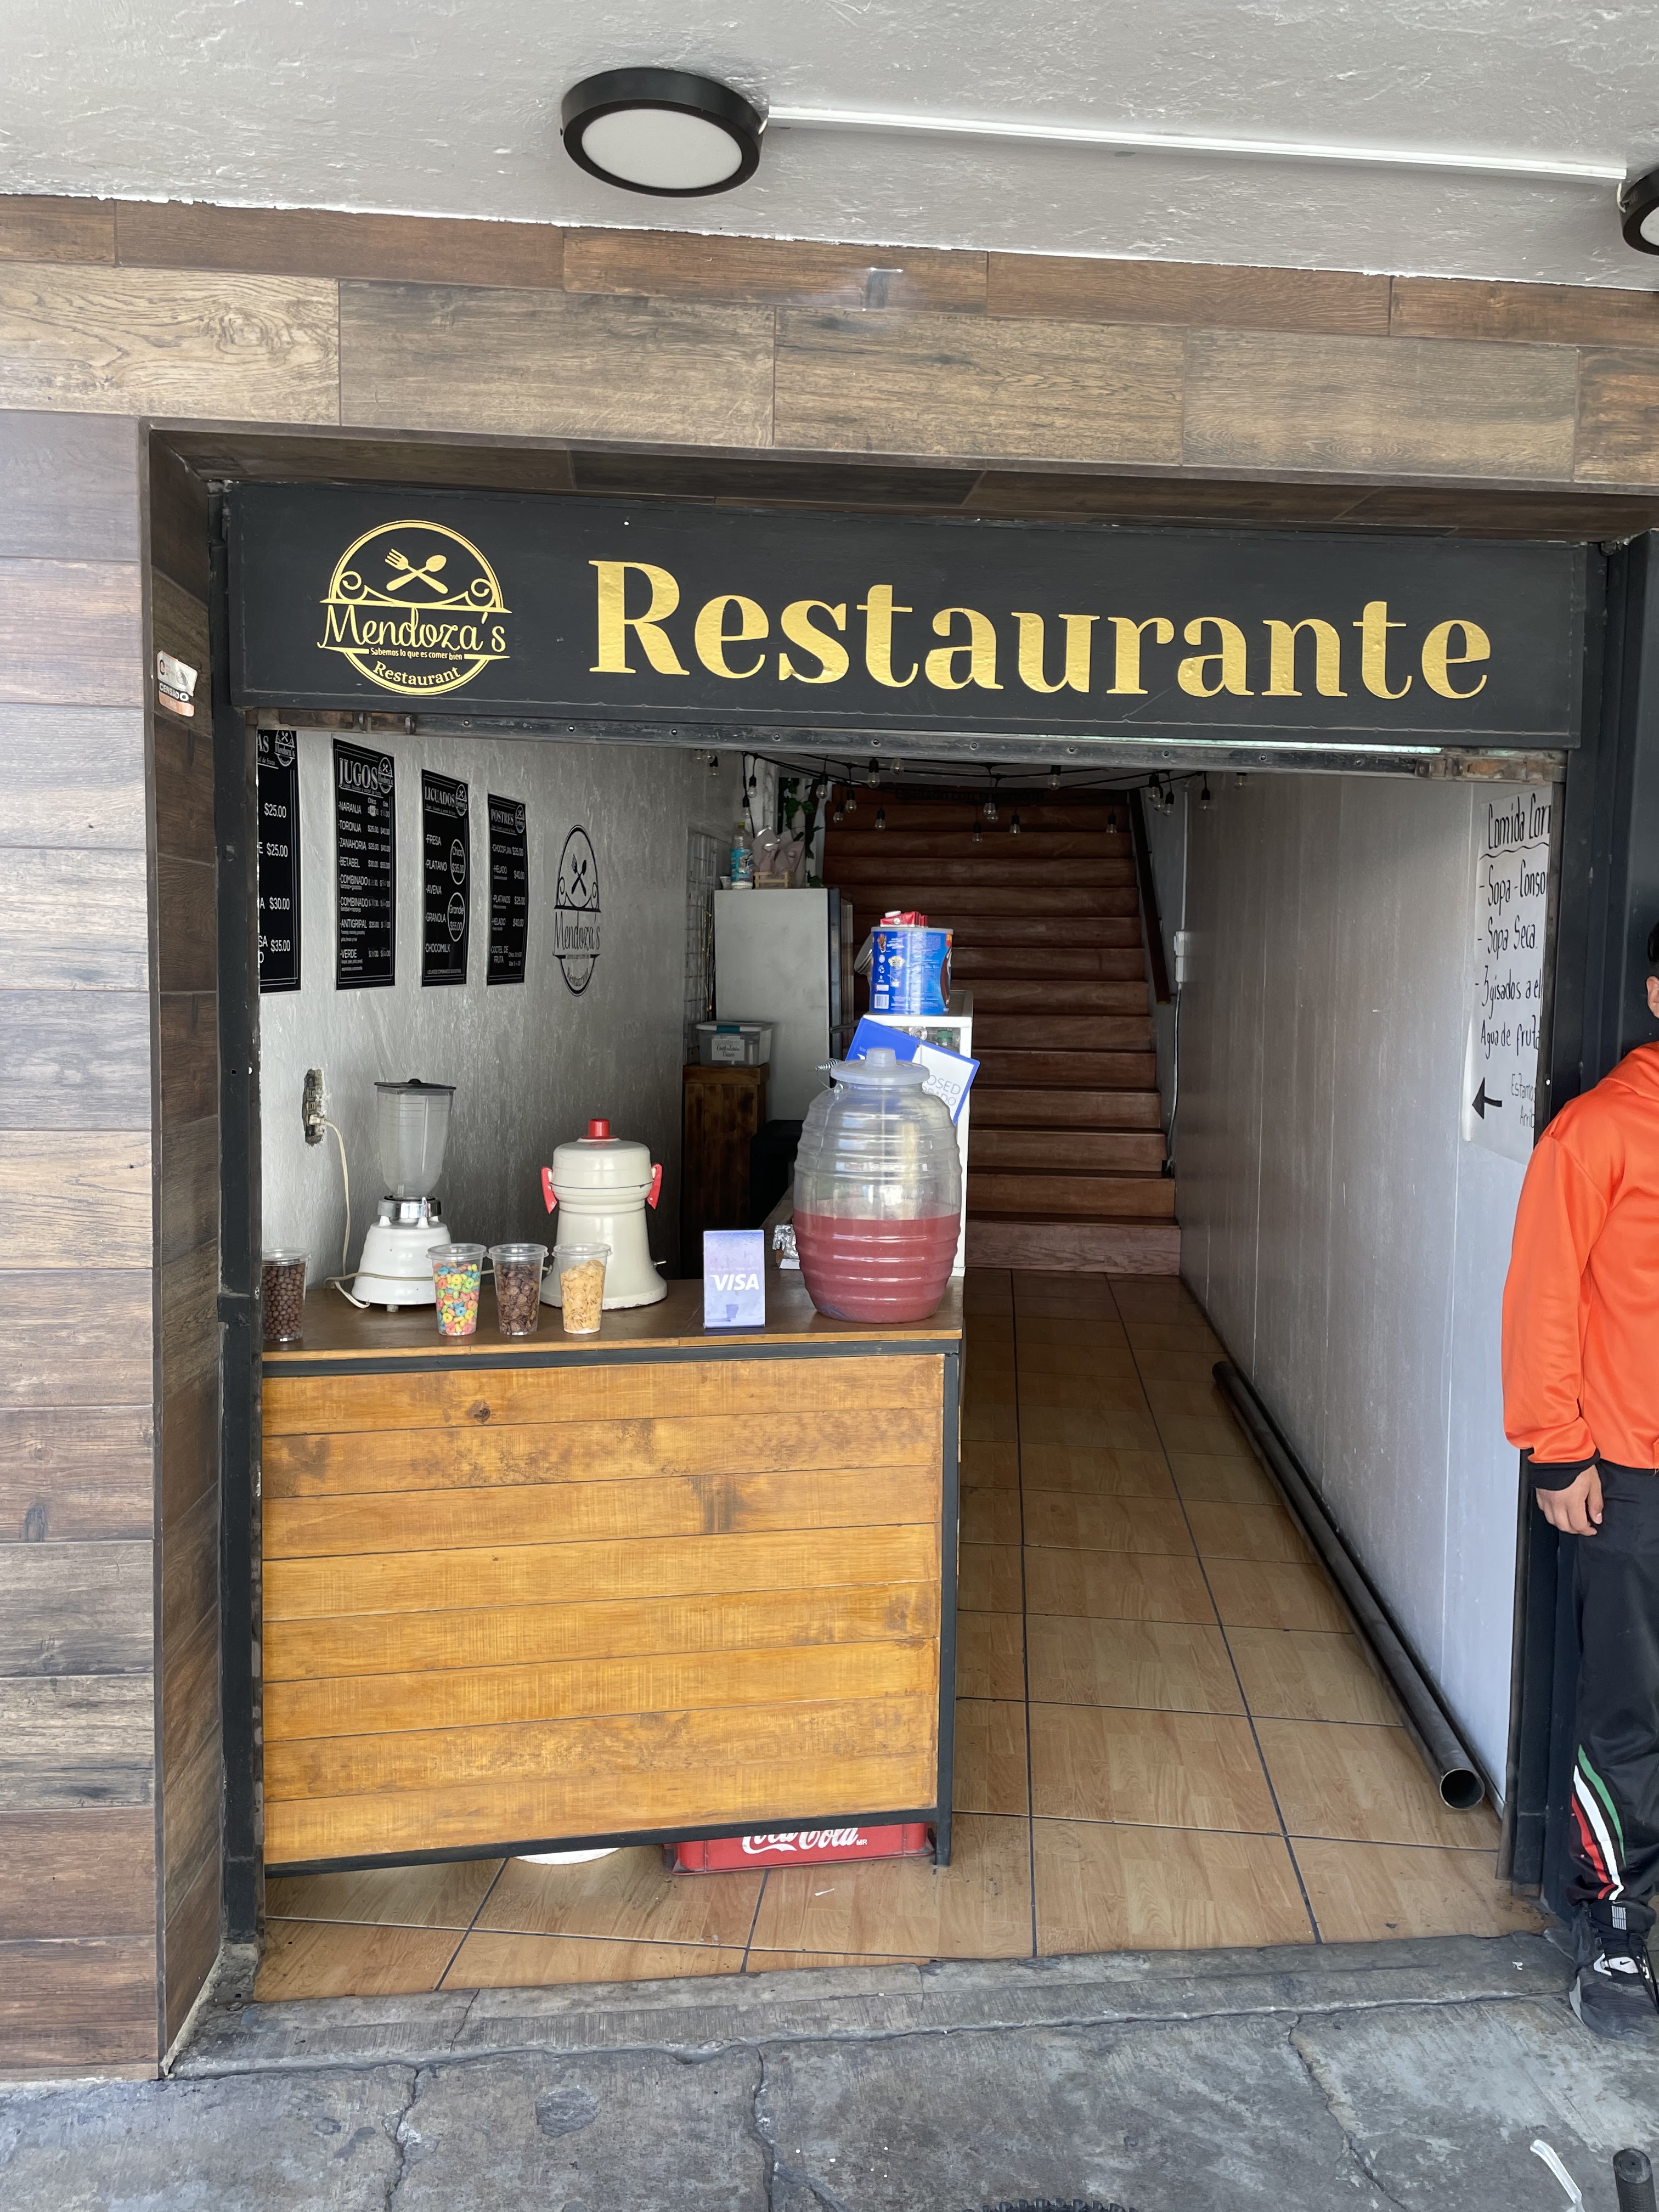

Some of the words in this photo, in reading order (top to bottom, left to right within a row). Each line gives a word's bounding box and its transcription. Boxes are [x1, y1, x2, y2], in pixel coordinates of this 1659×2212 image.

[317, 605, 506, 652] Mendoza's
[589, 559, 1493, 700] Restaurante
[370, 647, 399, 656] Sabemos
[449, 652, 462, 660] bien
[373, 661, 461, 686] Restaurant
[160, 682, 189, 701] CENSADO
[338, 758, 378, 790] JUGOS
[425, 786, 455, 808] LICUADOS
[264, 803, 286, 818] $25.00
[491, 809, 514, 826] POSTRES
[1488, 796, 1525, 849] Comida
[267, 842, 288, 857] $25.00
[1488, 864, 1510, 916] Sopa
[269, 896, 290, 911] $30.00
[552, 910, 600, 956] Mendoza's
[1487, 916, 1509, 961] Sopa
[270, 939, 291, 953] $35.00
[925, 1075, 961, 1094] OSED
[710, 1273, 760, 1291] VISA
